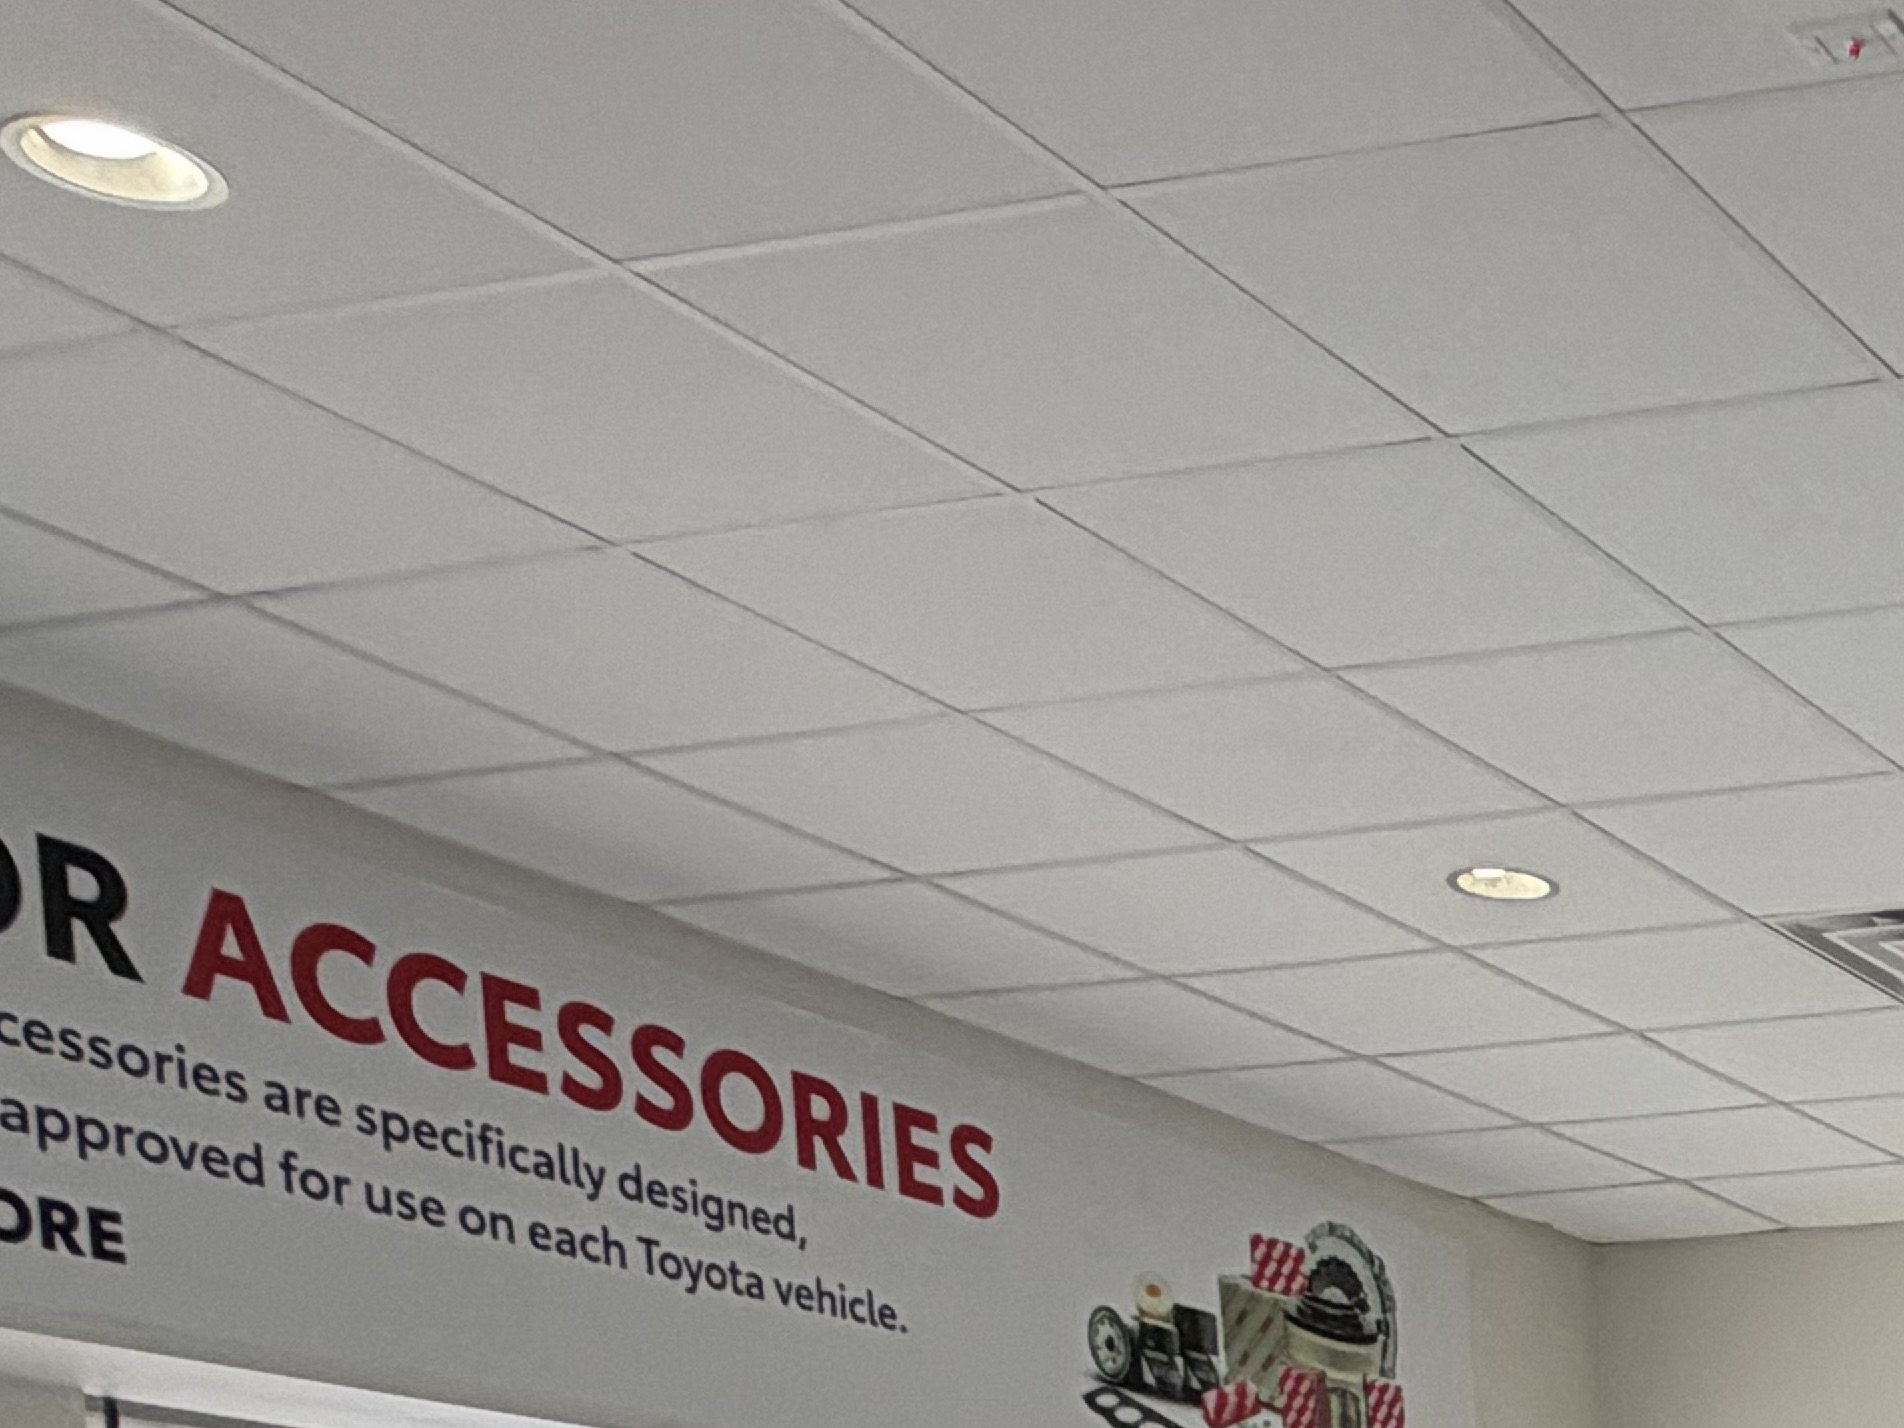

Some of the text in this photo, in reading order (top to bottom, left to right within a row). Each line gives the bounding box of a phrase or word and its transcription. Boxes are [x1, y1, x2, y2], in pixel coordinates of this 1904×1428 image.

[0, 833, 1000, 1219] R ACCESSORIES
[0, 1098, 909, 1335] approved for use on each Toyota vehicle.
[263, 1080, 342, 1128] are
[356, 1102, 605, 1201] specifically
[618, 1163, 808, 1251] designed,
